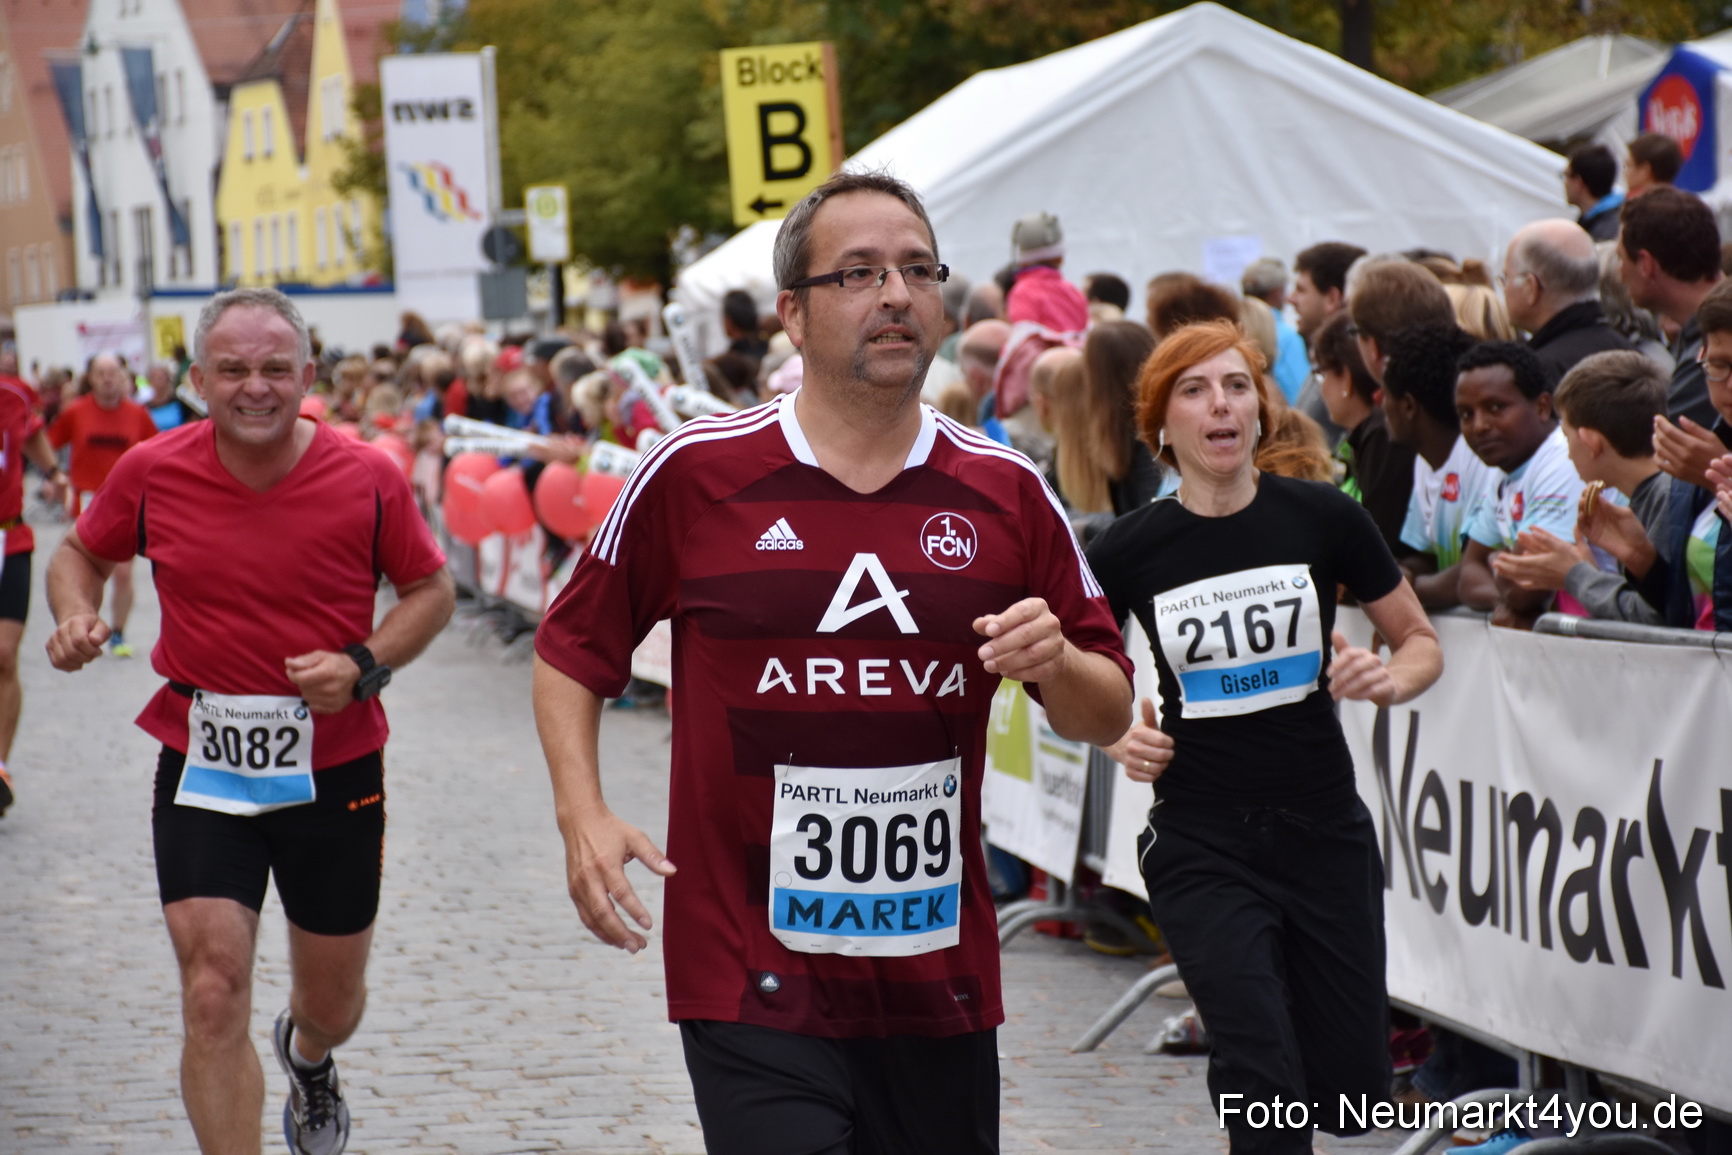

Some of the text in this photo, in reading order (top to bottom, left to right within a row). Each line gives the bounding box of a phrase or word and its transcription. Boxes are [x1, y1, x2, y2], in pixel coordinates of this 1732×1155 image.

[737, 54, 823, 86] Block
[758, 101, 812, 181] B
[755, 538, 804, 550] adidas
[927, 535, 971, 559] FCN
[1160, 580, 1286, 616] PARTL Neumarkt
[1177, 597, 1303, 665] 2167
[756, 657, 967, 697] AREVA
[1220, 668, 1279, 695] Gisela
[225, 708, 289, 720] Neumarkt
[201, 720, 300, 770] 3082
[781, 783, 938, 804] PARTL Neumarkt
[794, 808, 951, 883] 3069
[787, 893, 945, 930] MAREK
